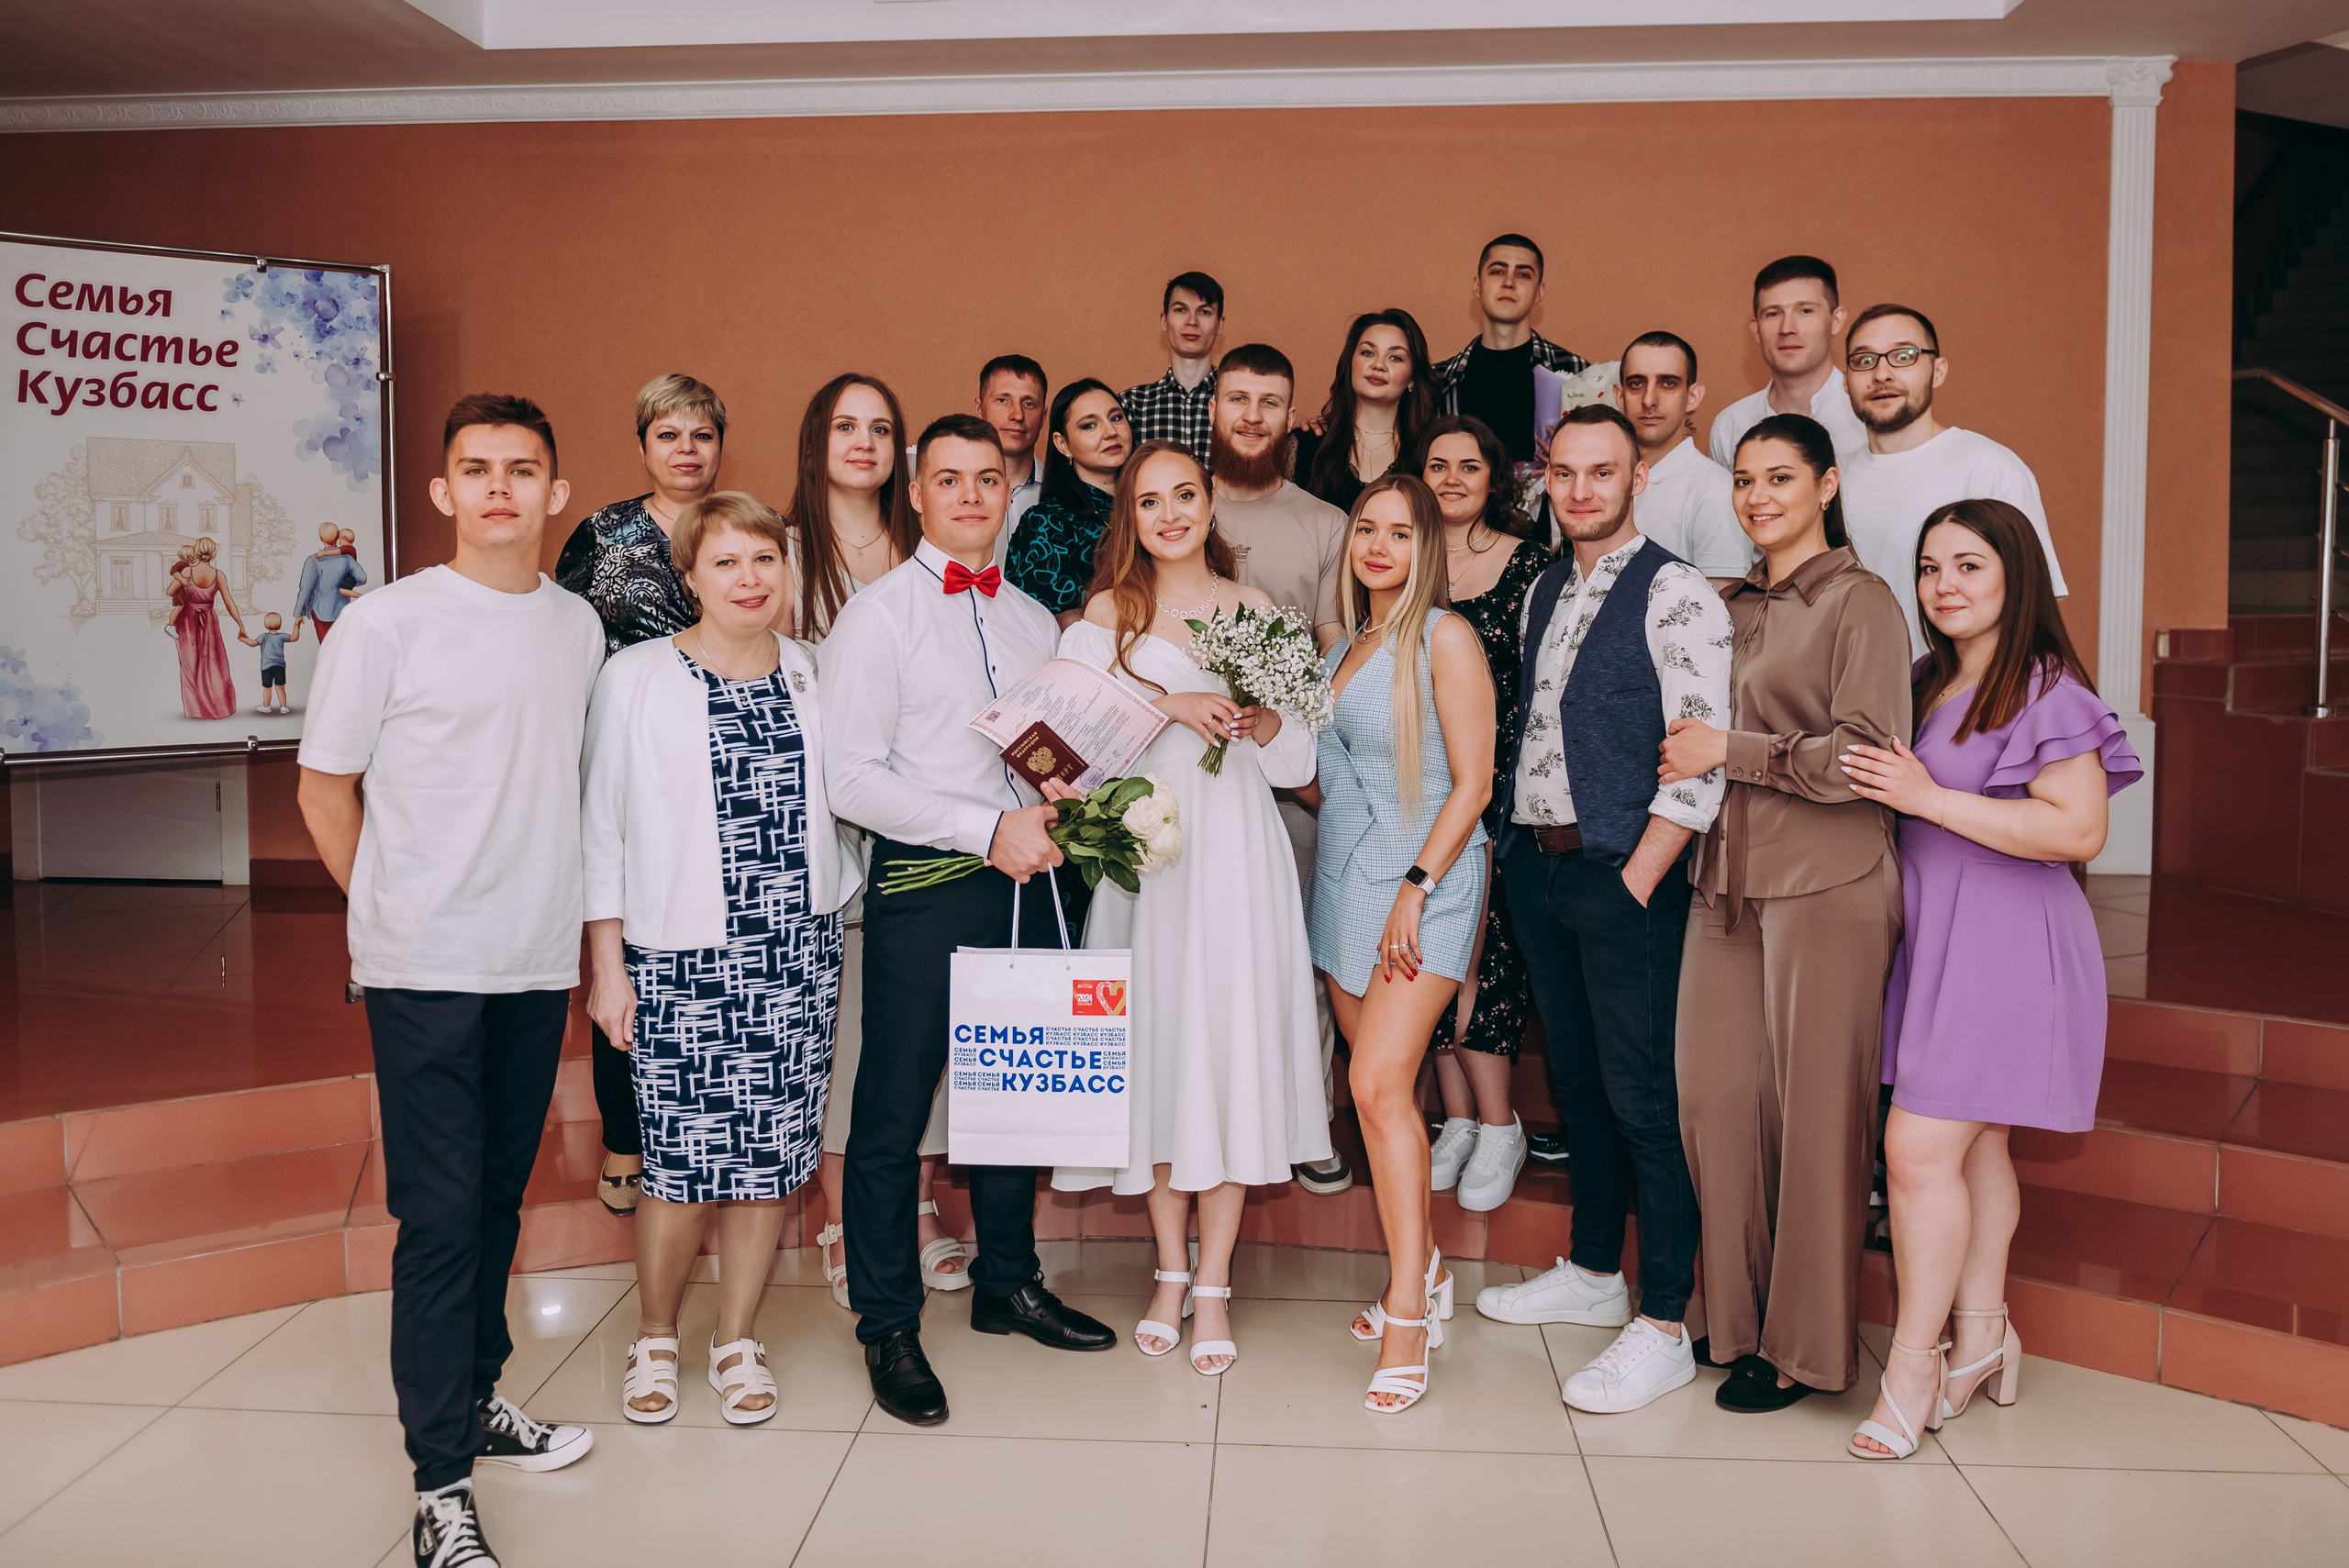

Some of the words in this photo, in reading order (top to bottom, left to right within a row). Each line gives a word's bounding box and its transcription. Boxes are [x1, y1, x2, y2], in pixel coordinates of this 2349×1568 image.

[15, 272, 173, 317] Семья
[16, 321, 239, 368] Счастье
[17, 369, 219, 417] Кузбасс
[1055, 762, 1074, 781] ПОРТ
[954, 1024, 1044, 1045] СЕМЬЯ
[979, 1048, 1102, 1070] СЧАСТЬЕ
[1002, 1073, 1125, 1095] КУЗБАСС
